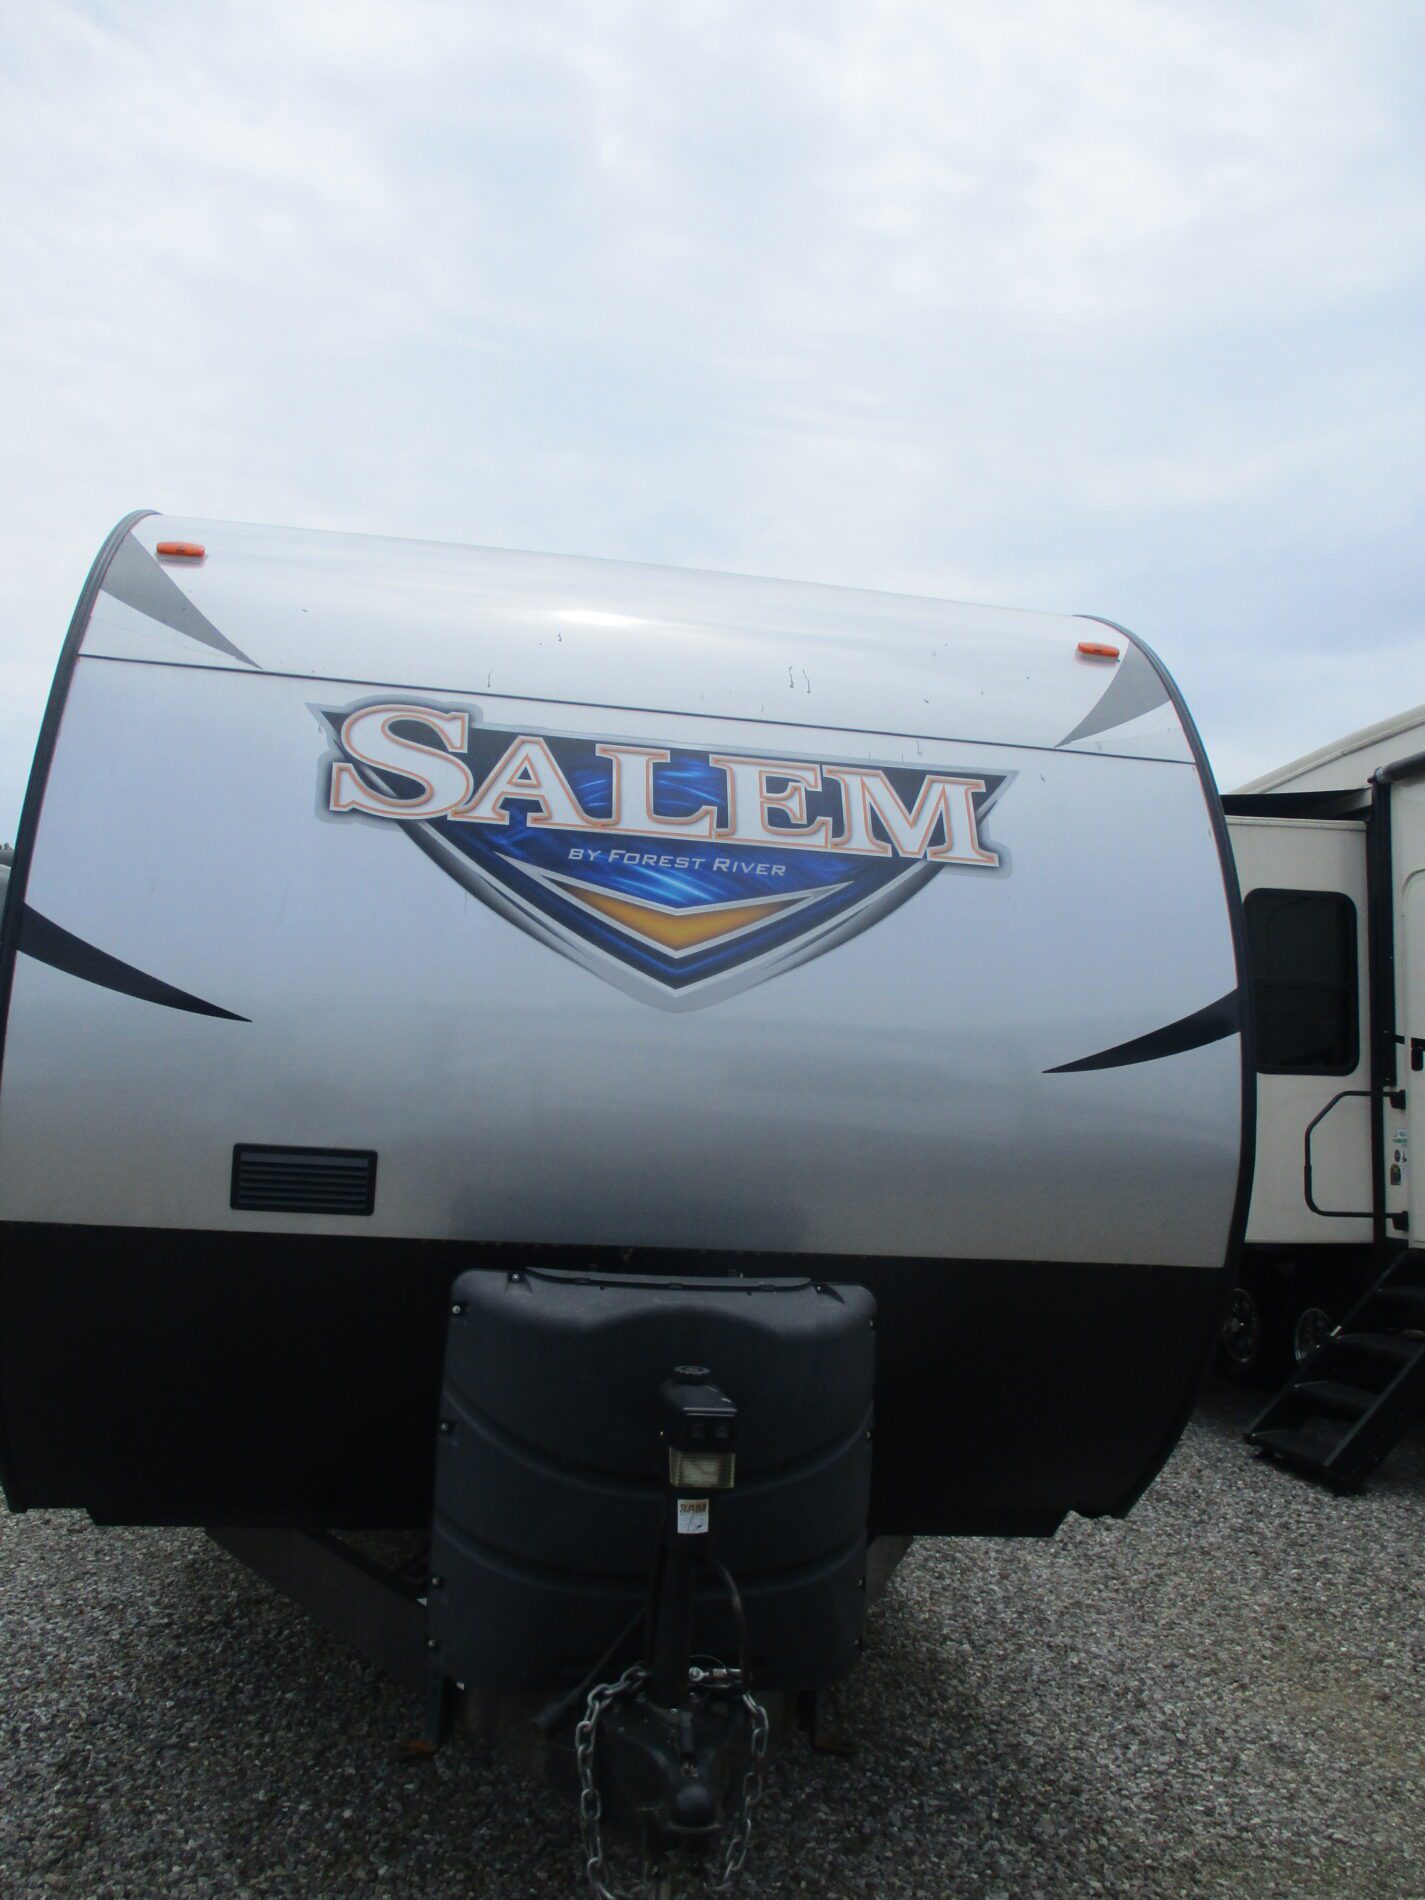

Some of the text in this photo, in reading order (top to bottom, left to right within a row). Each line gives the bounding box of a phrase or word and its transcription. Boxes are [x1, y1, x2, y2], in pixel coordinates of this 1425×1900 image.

[330, 704, 999, 867] SALEM
[568, 848, 786, 876] BY FOREST RIVER
